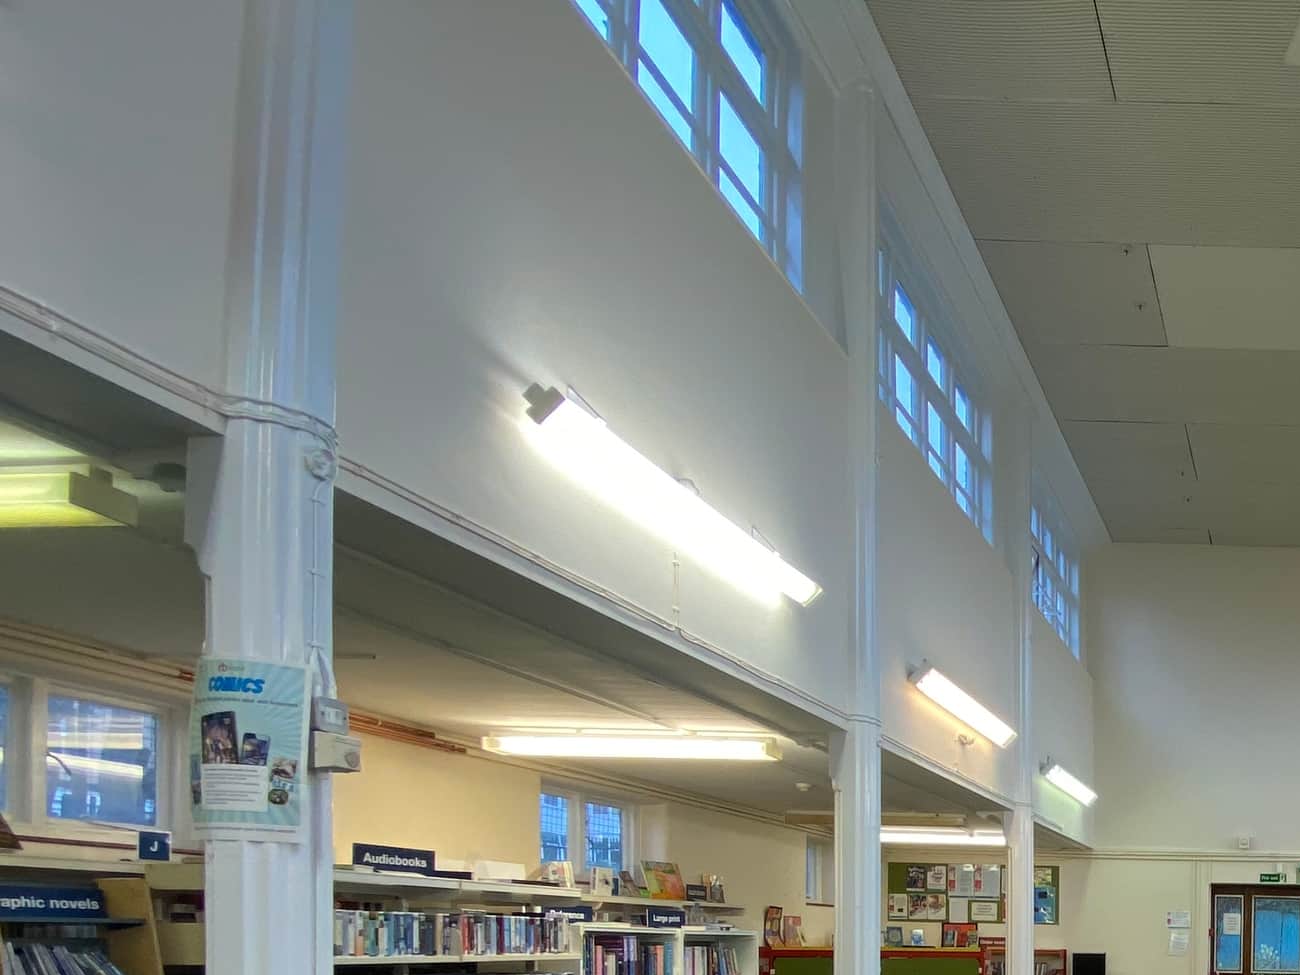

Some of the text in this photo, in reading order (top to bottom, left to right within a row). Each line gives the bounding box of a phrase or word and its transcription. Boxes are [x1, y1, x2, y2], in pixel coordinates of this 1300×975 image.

[208, 676, 265, 694] COMICS
[150, 840, 158, 852] J
[363, 852, 427, 868] Audiobooks
[49, 897, 100, 910] novels
[653, 914, 668, 924] Large
